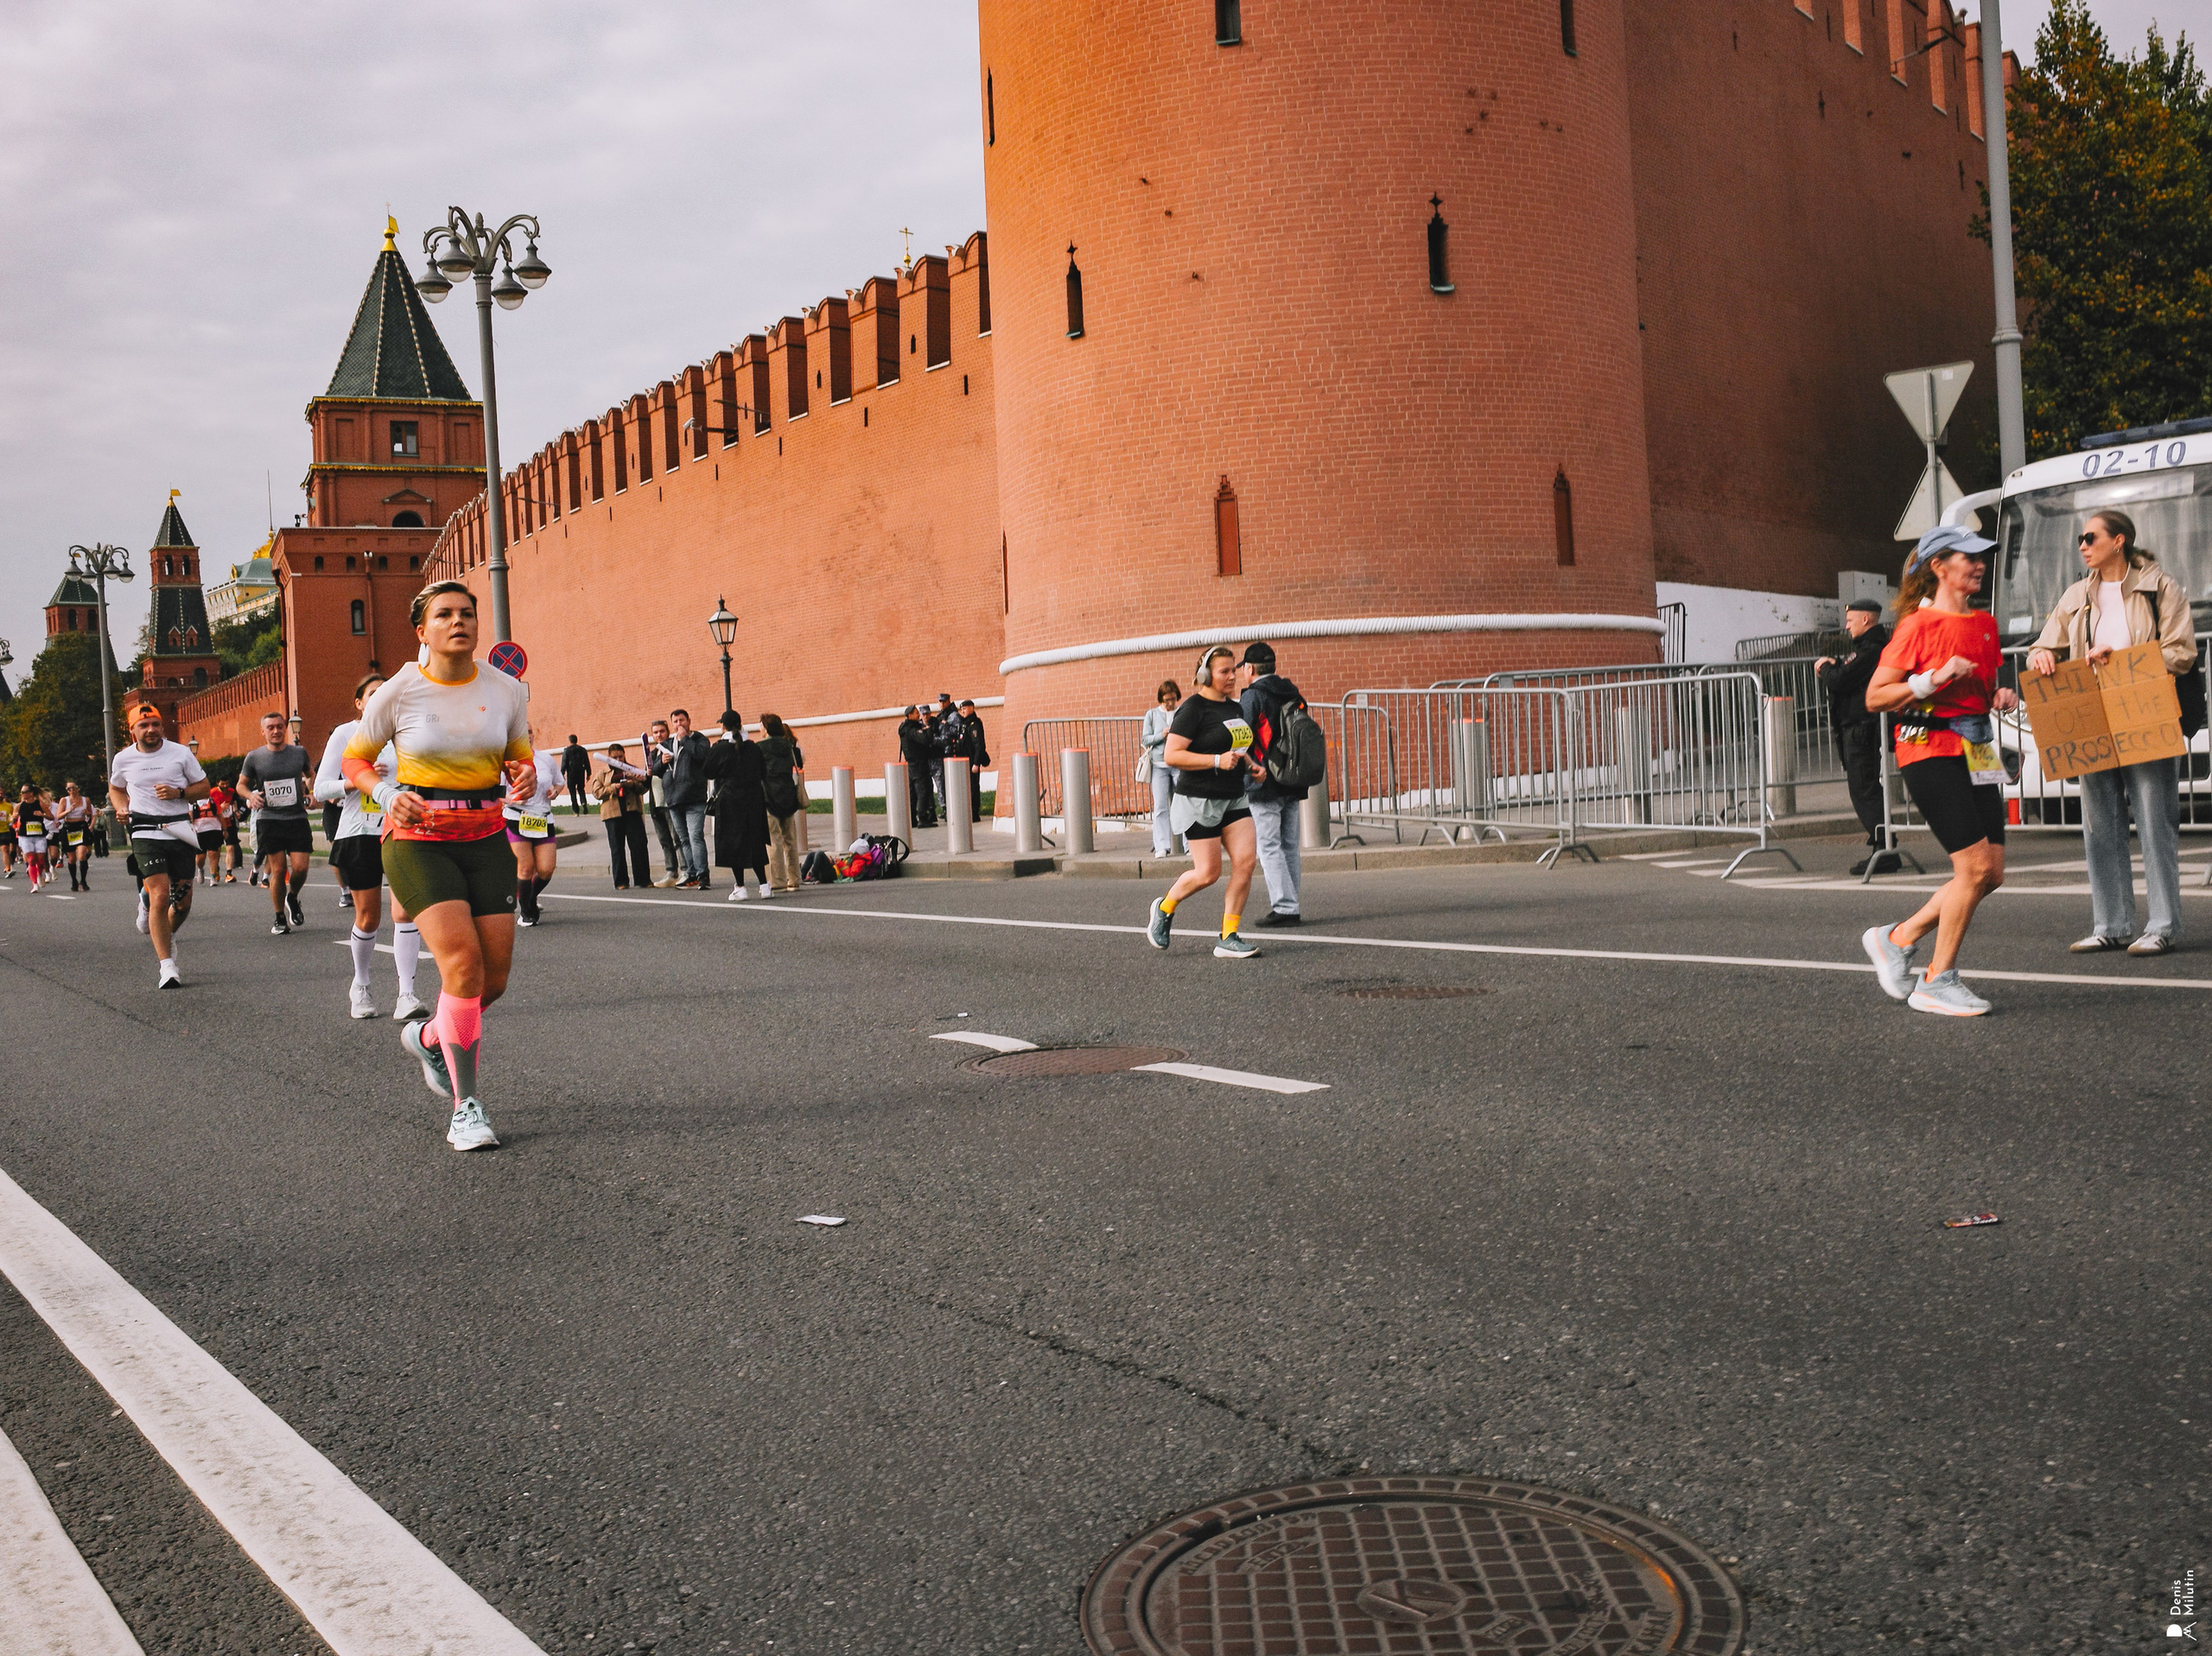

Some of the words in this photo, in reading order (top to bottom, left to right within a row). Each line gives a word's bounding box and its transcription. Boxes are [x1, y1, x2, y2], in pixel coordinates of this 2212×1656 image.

[2082, 441, 2187, 479] 02-10
[269, 785, 292, 796] 3070
[521, 816, 547, 828] 18703
